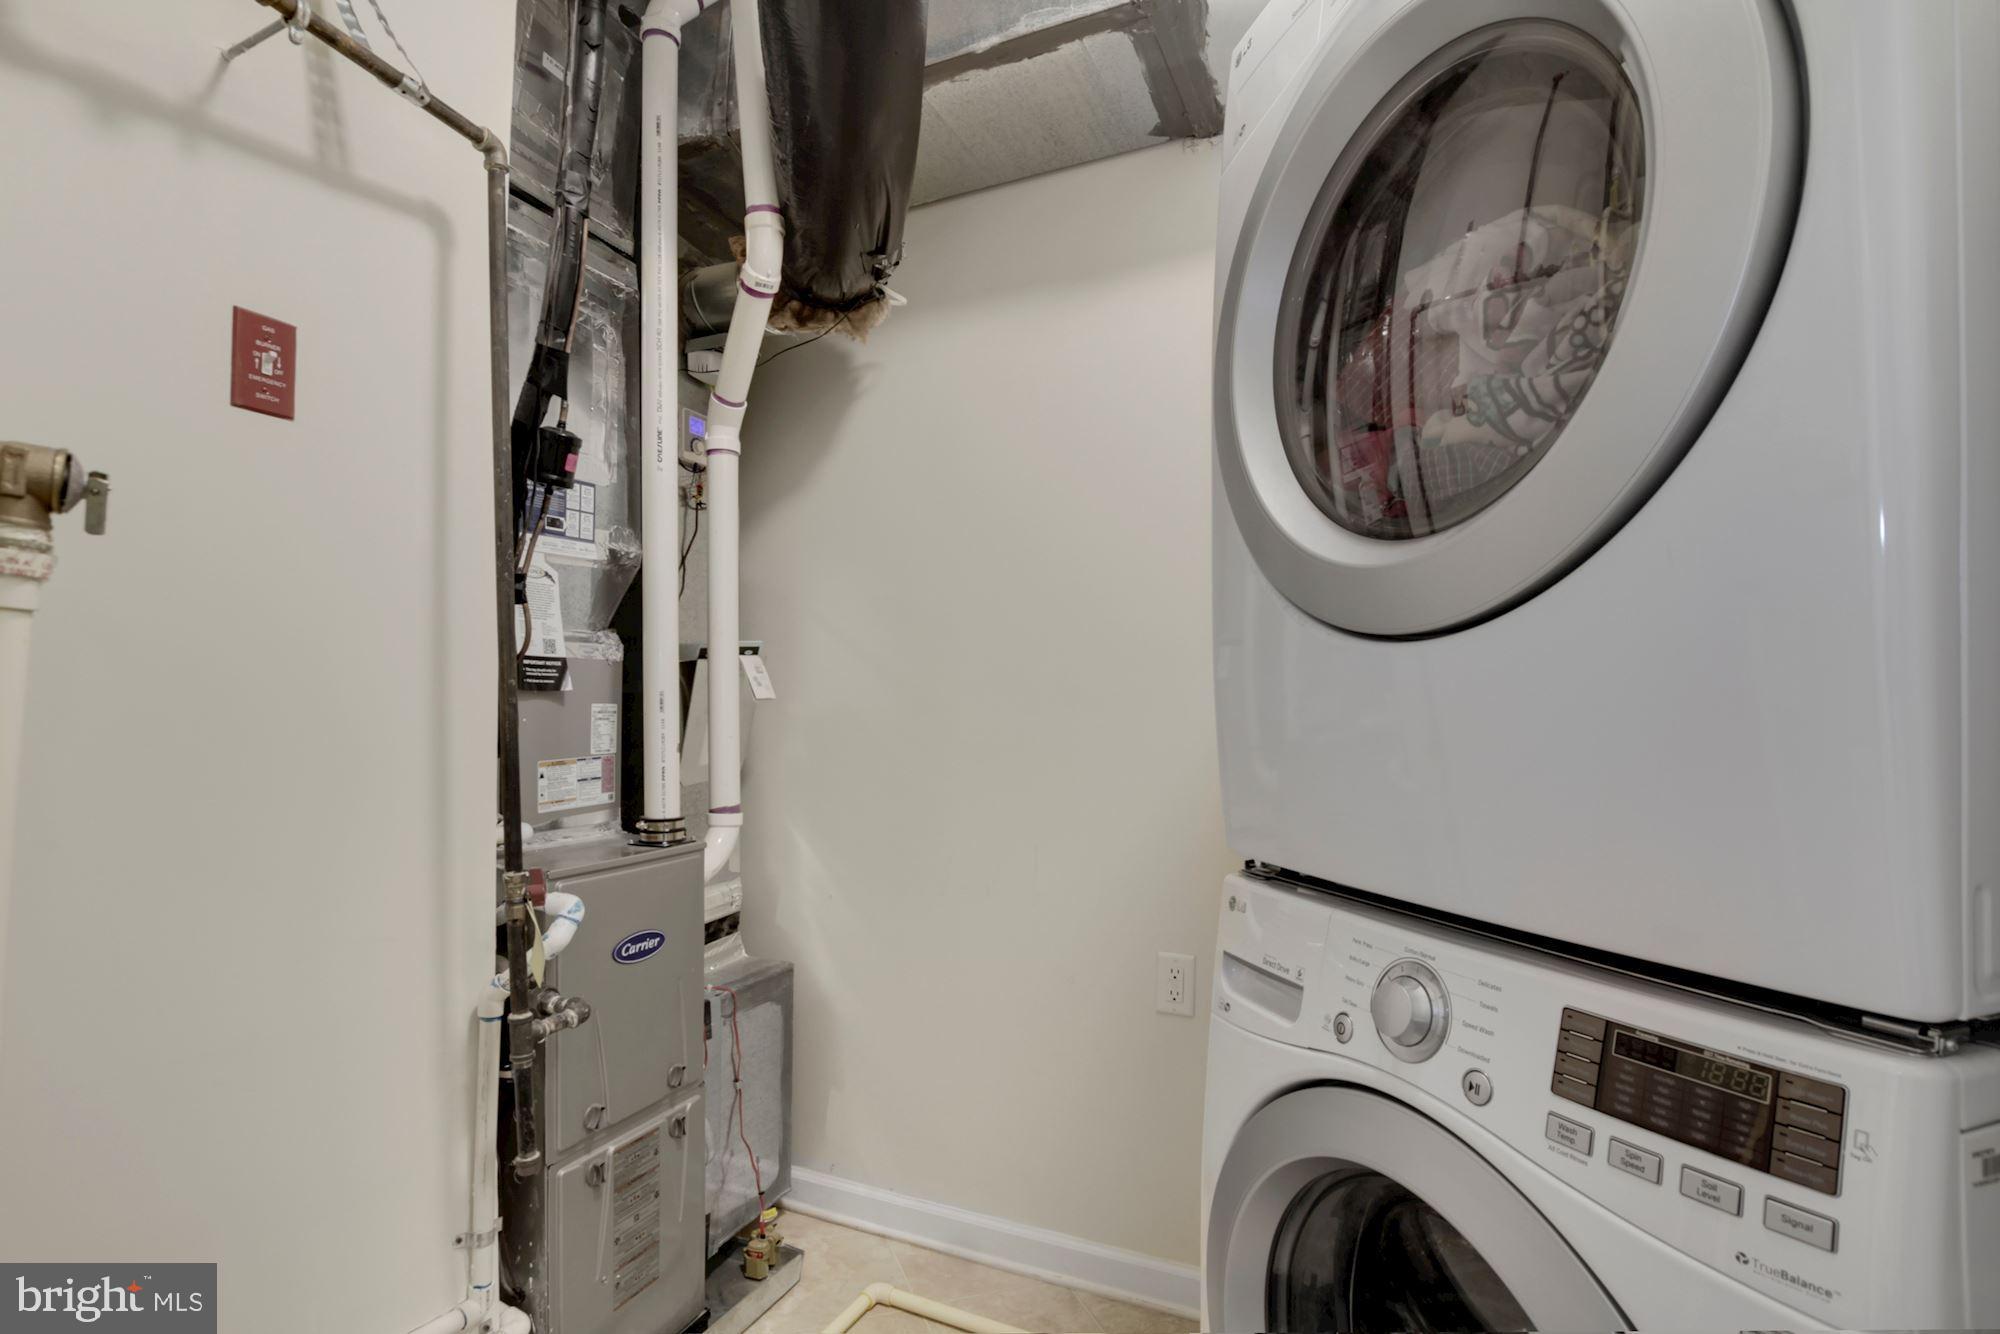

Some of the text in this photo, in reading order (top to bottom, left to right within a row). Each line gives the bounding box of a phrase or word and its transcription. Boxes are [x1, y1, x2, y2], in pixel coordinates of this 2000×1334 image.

[261, 325, 275, 334] GAS
[255, 339, 281, 352] BURNER
[248, 373, 286, 388] EMERGENCY
[255, 392, 280, 402] SWITCH
[621, 937, 660, 957] Carrier
[1262, 956, 1290, 975] Direct Drive
[1477, 978, 1503, 993] Delicates
[1480, 1001, 1498, 1013] Towels
[1462, 1019, 1478, 1032] Speed
[1558, 1122, 1578, 1137] Wash
[1625, 1149, 1642, 1163] Spin
[1621, 1157, 1645, 1173] Speed
[1701, 1179, 1718, 1193] Soil
[1697, 1187, 1721, 1203] Level
[1781, 1214, 1814, 1233] Signal
